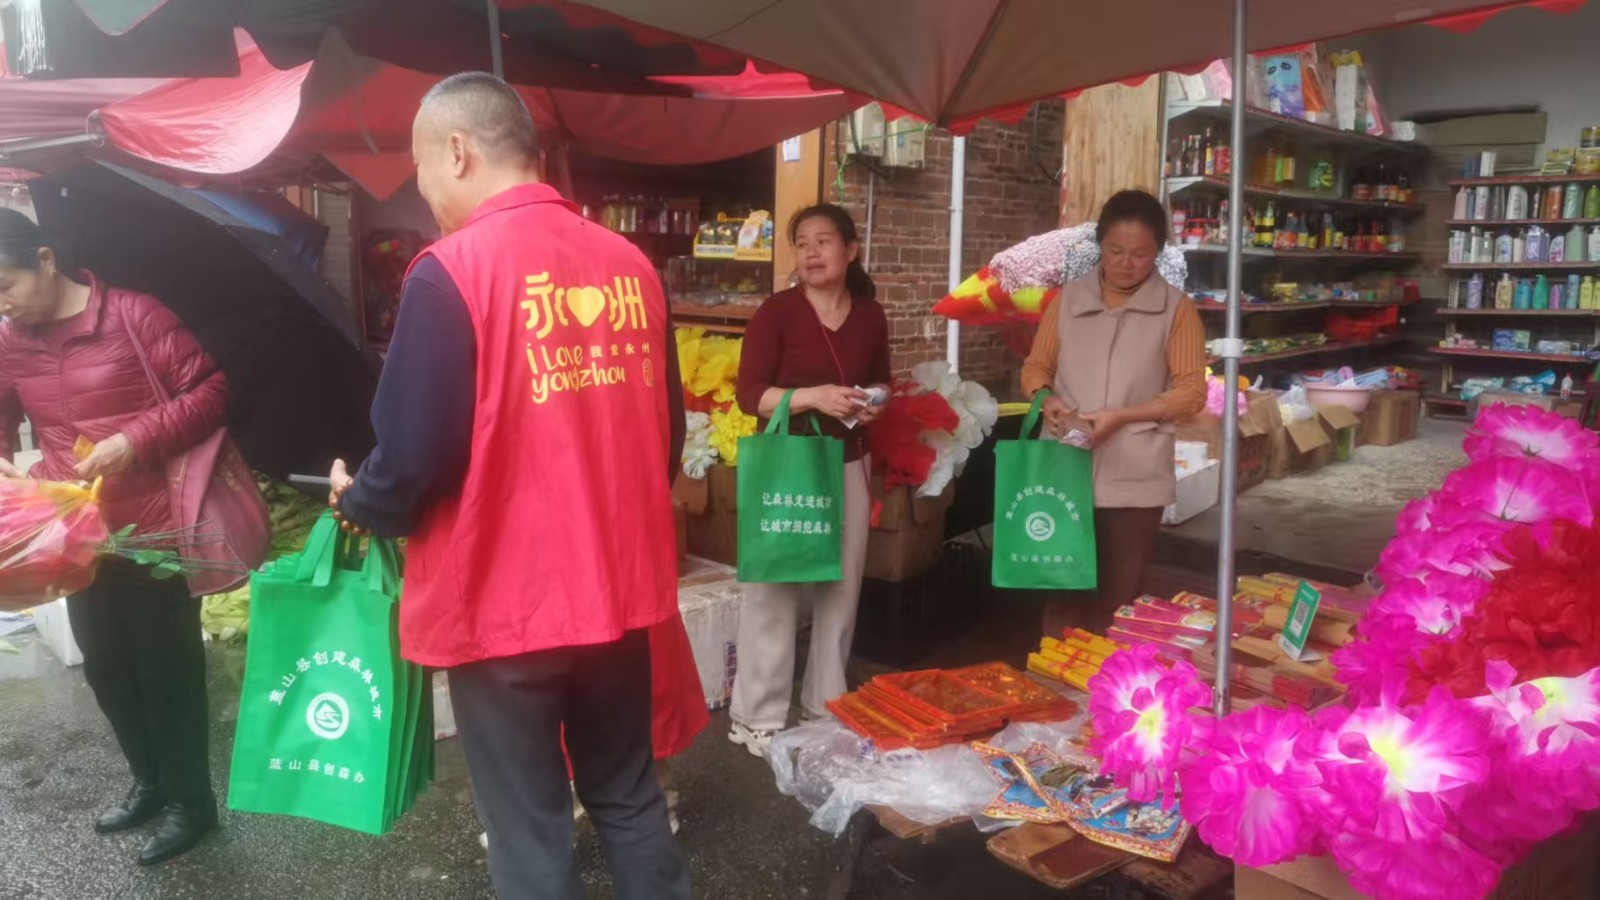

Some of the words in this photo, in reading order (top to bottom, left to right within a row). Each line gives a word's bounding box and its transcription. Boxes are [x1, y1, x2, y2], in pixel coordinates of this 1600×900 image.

[526, 342, 539, 375] i
[531, 361, 626, 404] yongzhou
[268, 651, 383, 721] 蓝山县创建森林城市
[269, 758, 365, 784] 蓝山县创森办
